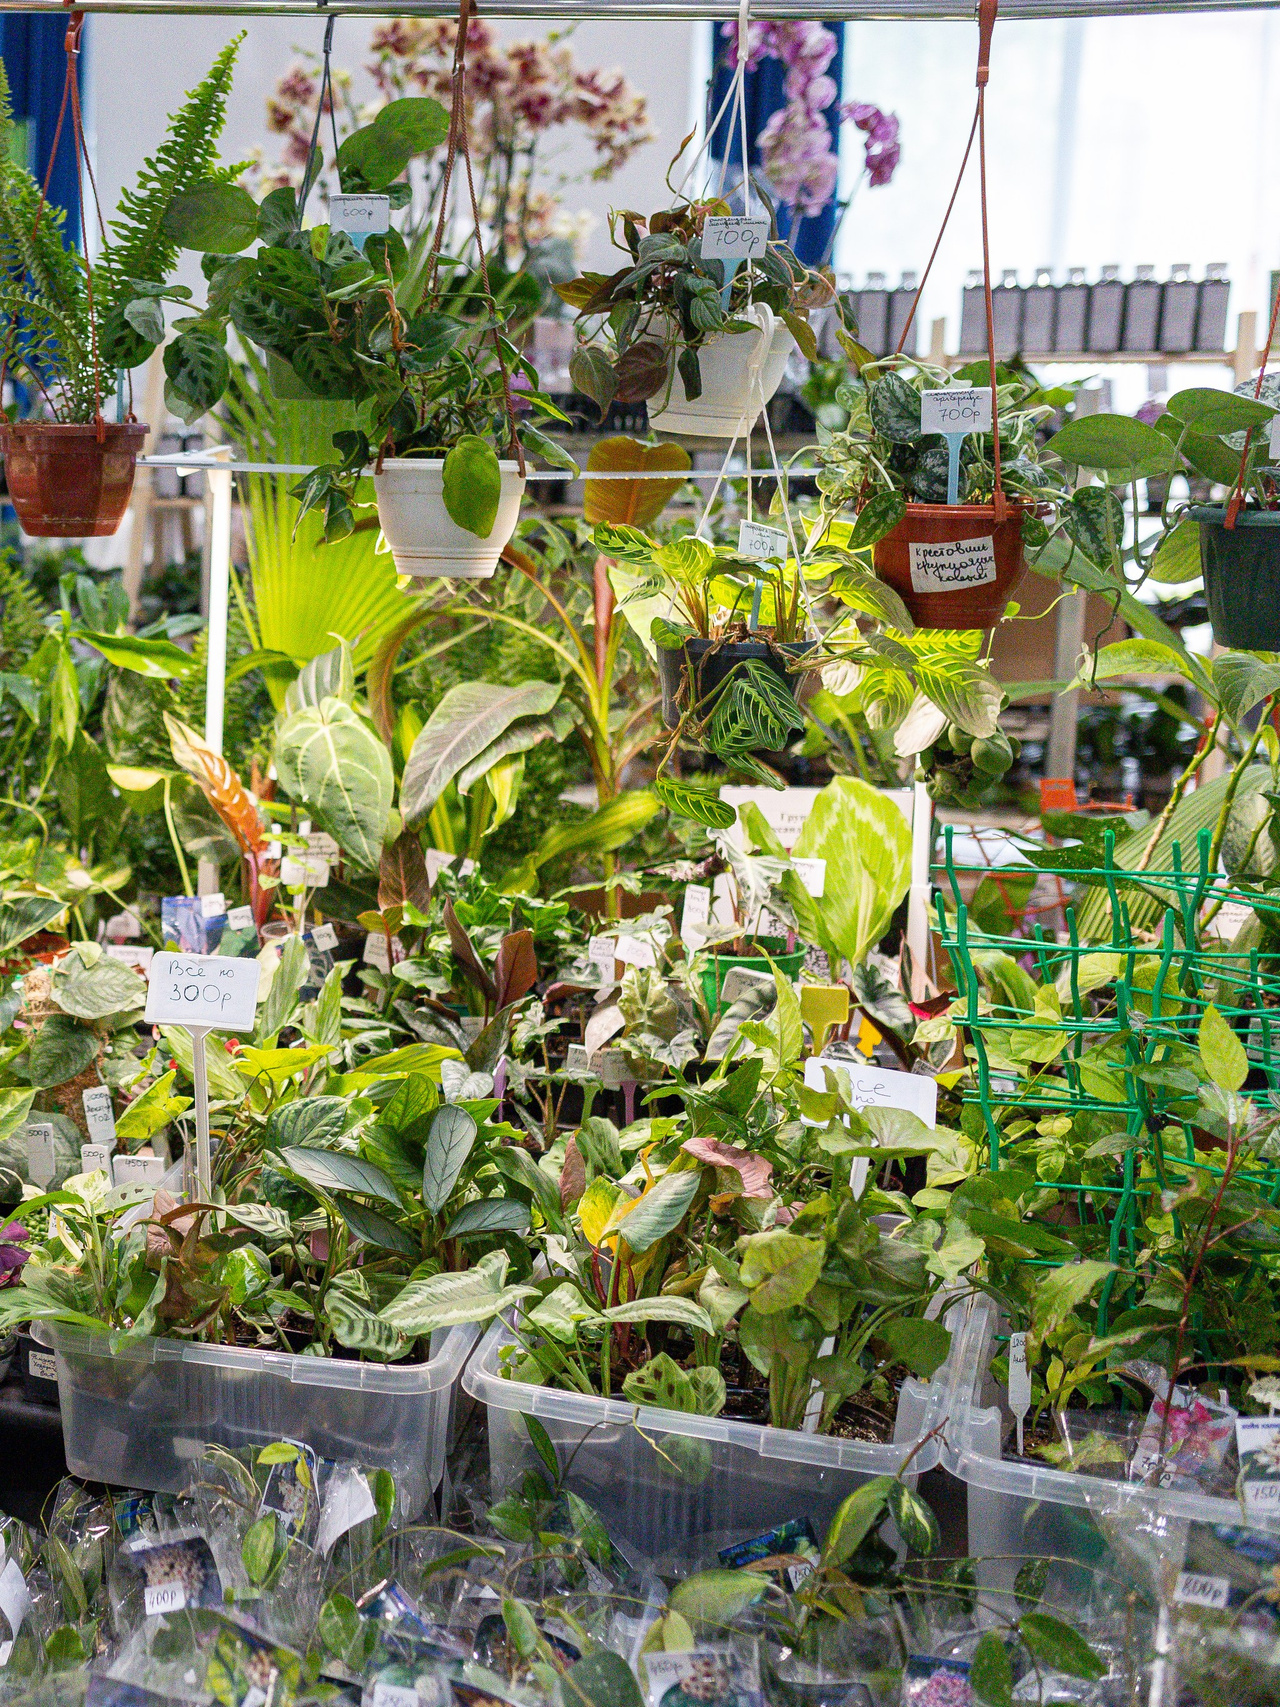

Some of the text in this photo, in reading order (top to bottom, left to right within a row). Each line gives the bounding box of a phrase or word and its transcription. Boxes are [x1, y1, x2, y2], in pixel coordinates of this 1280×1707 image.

[713, 229, 760, 253] 700р
[938, 407, 981, 424] 700р
[168, 959, 235, 979] Все по
[169, 983, 233, 1011] 300р
[27, 1129, 50, 1143] 500р
[82, 1150, 105, 1164] 500р
[124, 1159, 149, 1174] 450р
[148, 1590, 177, 1608] 400р
